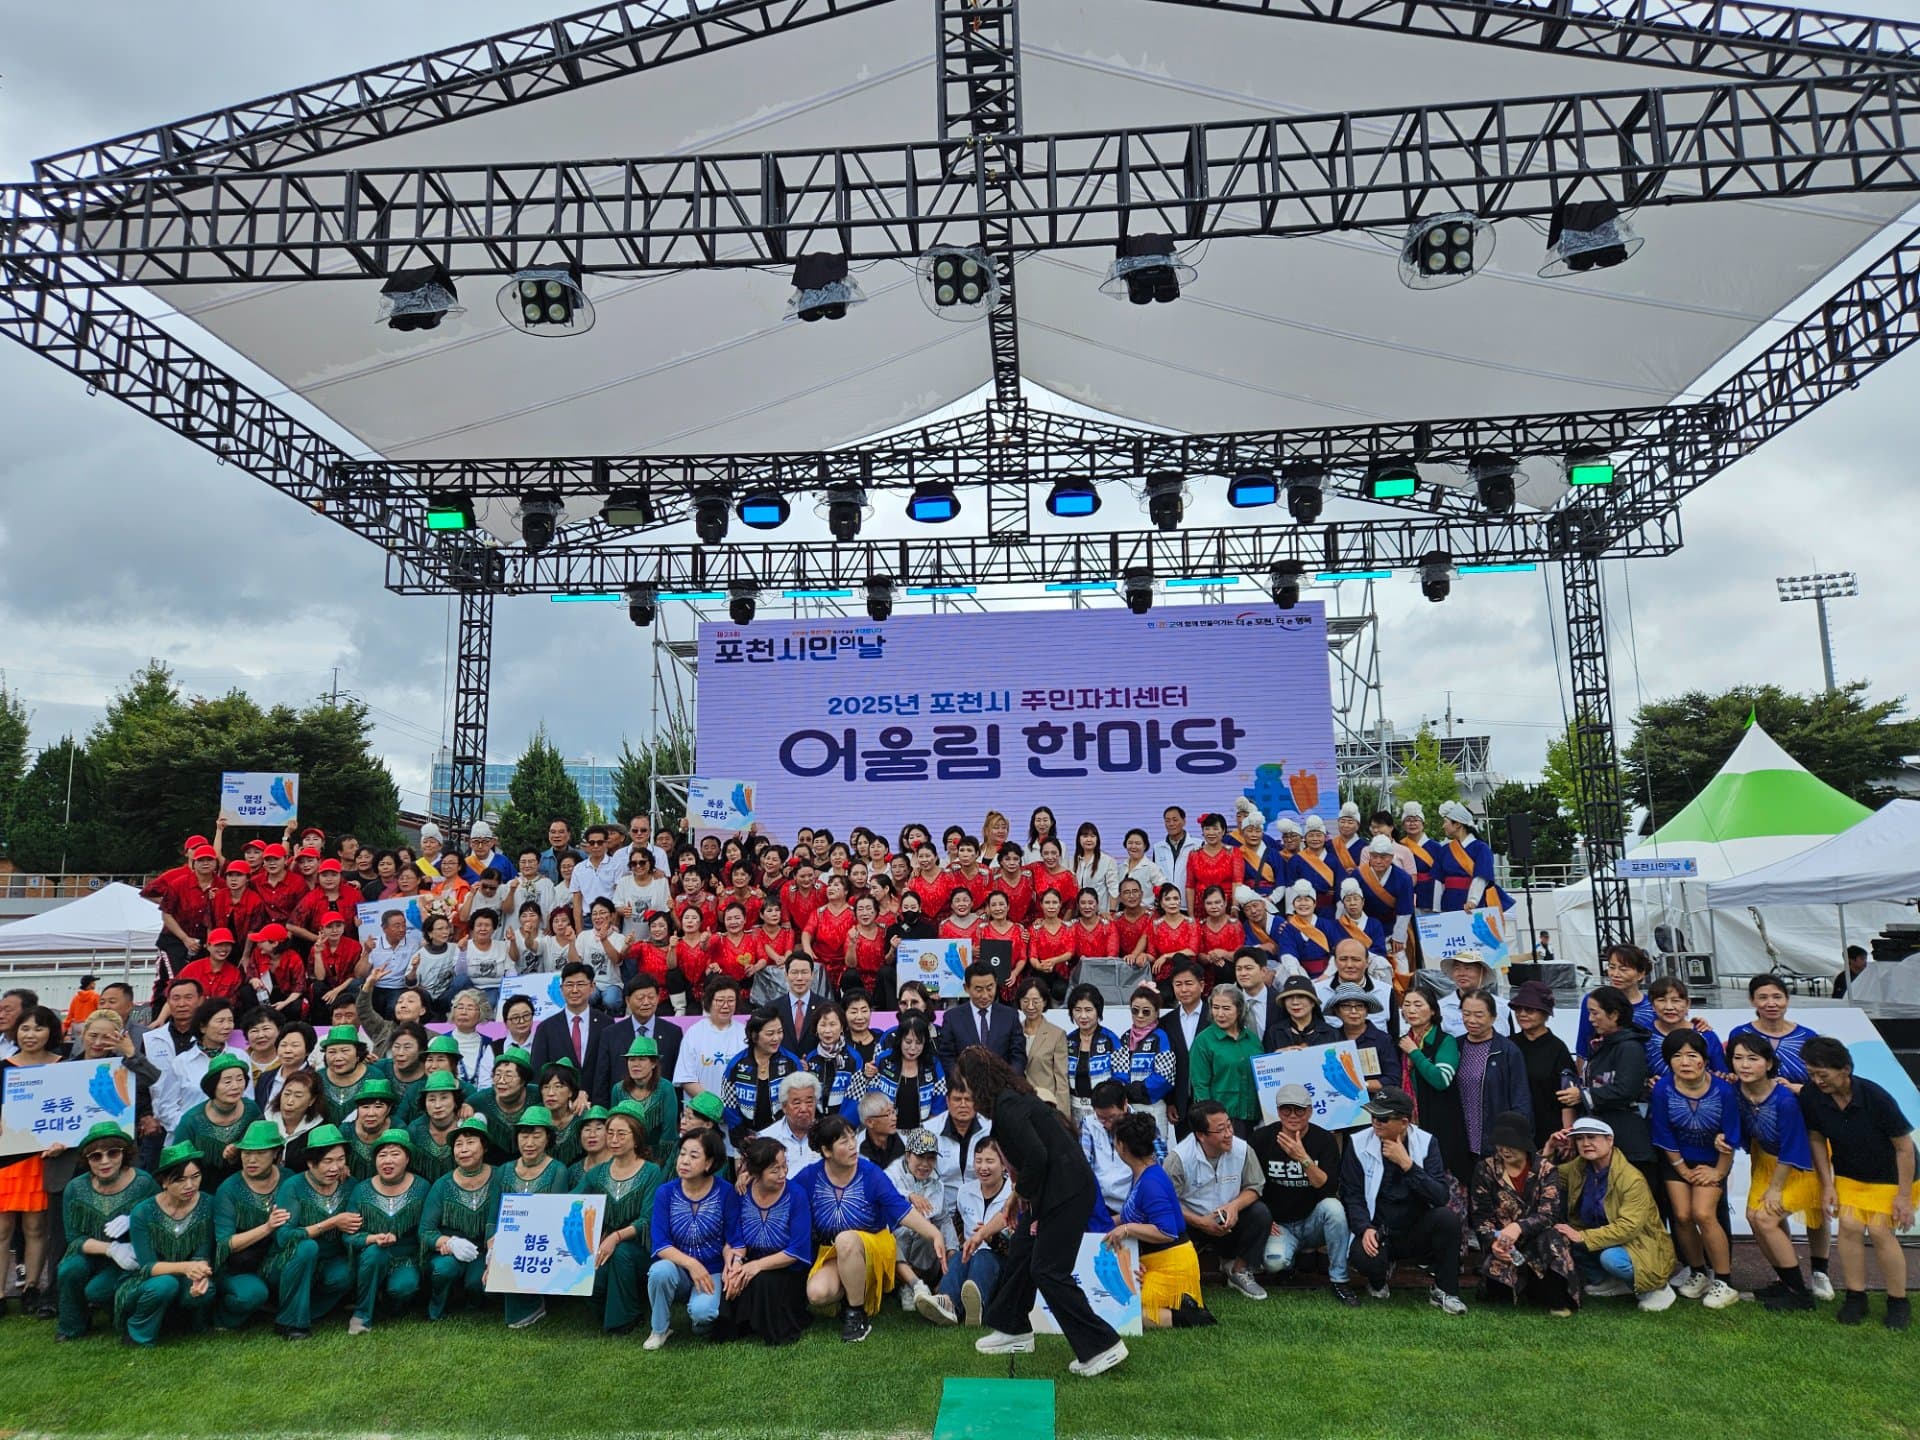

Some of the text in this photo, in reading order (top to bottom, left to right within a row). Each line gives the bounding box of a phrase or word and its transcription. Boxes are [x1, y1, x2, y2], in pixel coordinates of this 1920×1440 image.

[826, 685, 1189, 716] 2025년 포천시 주민자치센터
[778, 717, 1247, 783] 어울림 한마당
[41, 1097, 75, 1113] 폭풍
[31, 1115, 82, 1134] 무대상
[525, 1234, 550, 1252] 협동
[513, 1255, 554, 1274] 최강상
